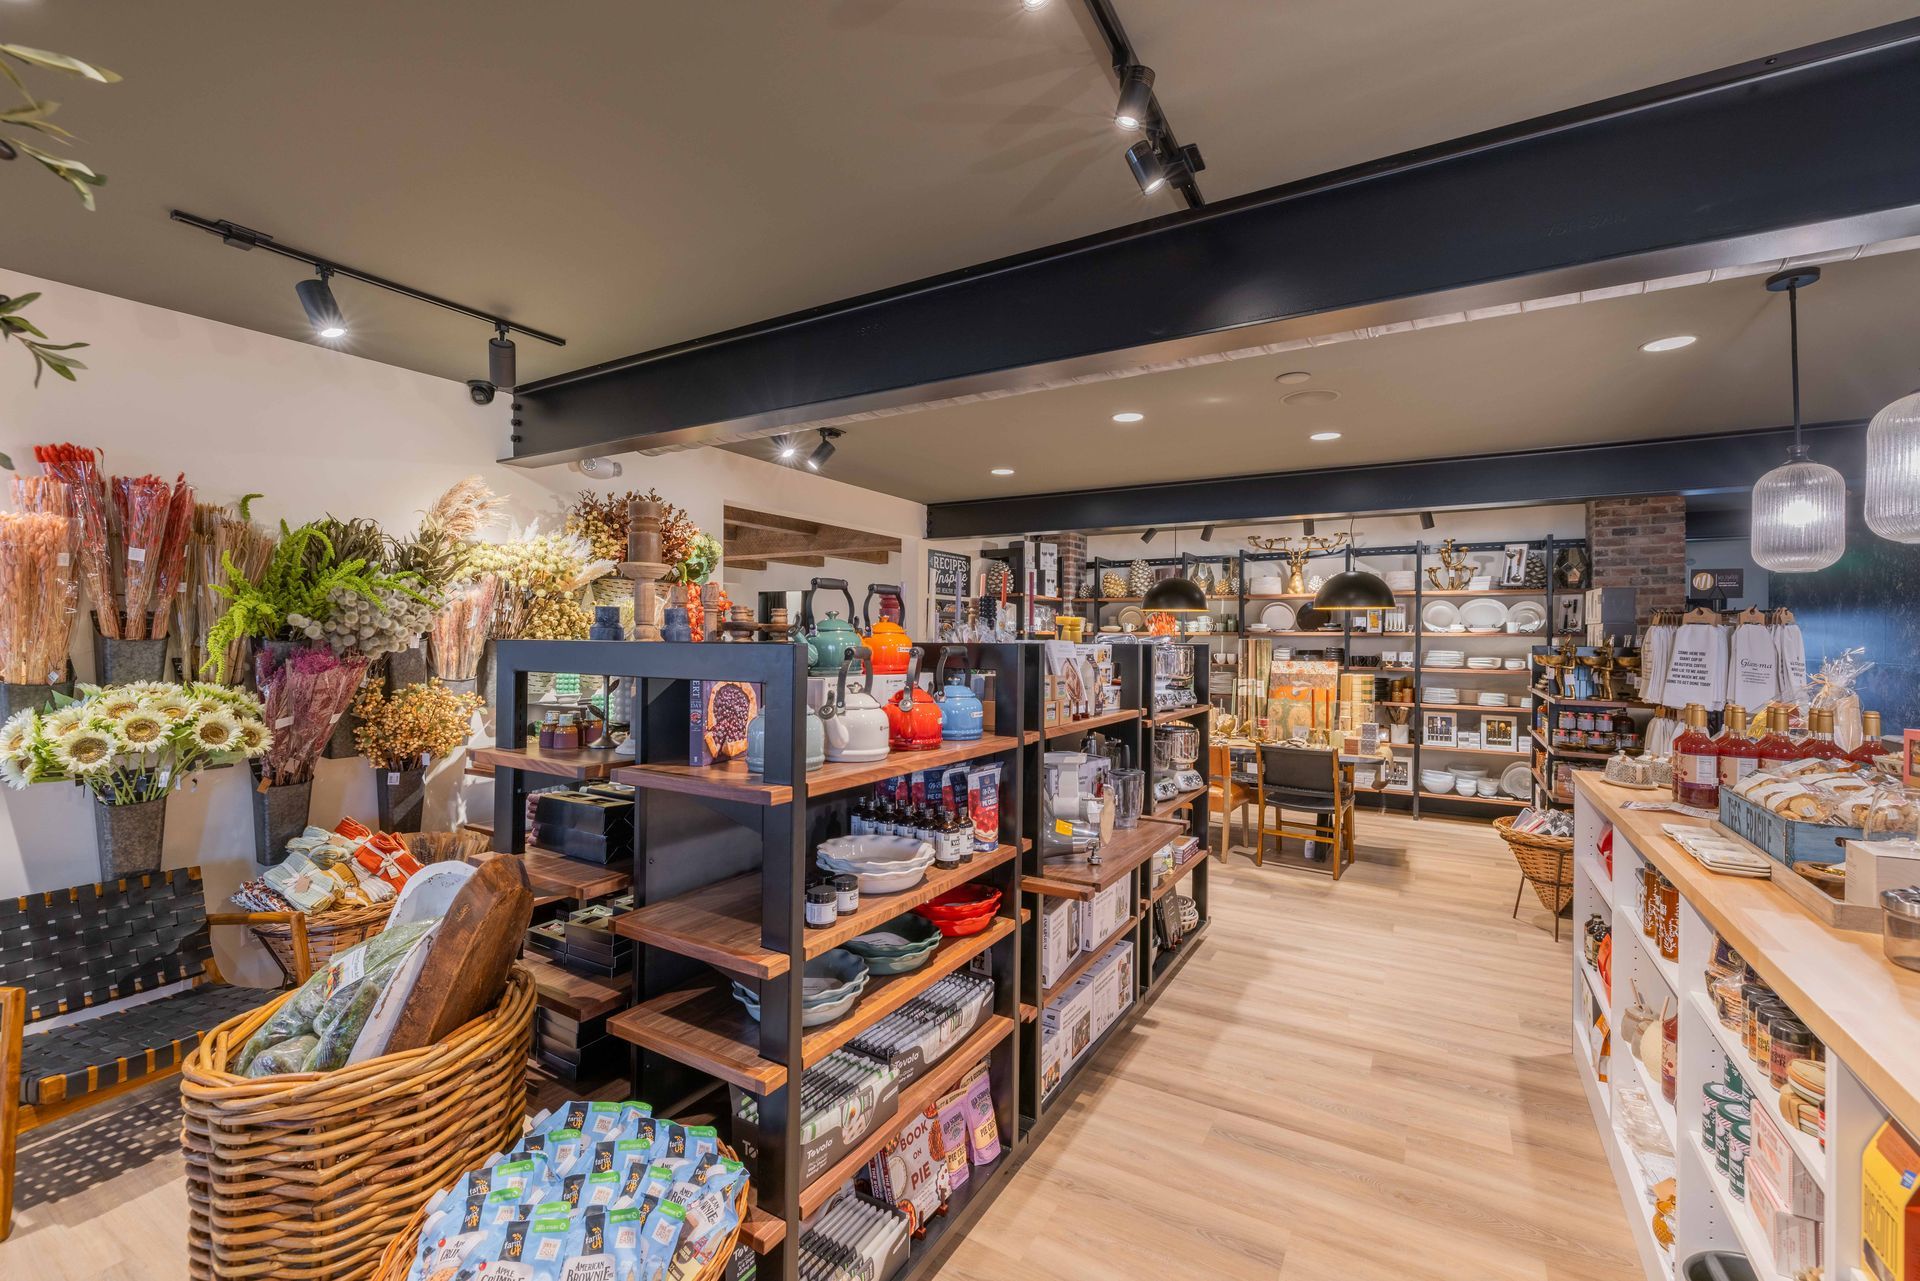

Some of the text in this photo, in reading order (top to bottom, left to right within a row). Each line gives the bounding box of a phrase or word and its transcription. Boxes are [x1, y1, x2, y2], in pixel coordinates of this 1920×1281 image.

[933, 556, 967, 572] RECIPES
[935, 570, 968, 588] Inspe
[899, 1119, 928, 1152] BOOK
[806, 1138, 833, 1160] Tovolo
[913, 1148, 922, 1160] ON
[911, 1160, 931, 1191] PIE
[495, 1266, 516, 1278] APPLE
[566, 1265, 611, 1281] BROWNIE
[575, 1261, 605, 1272] AMERICAN
